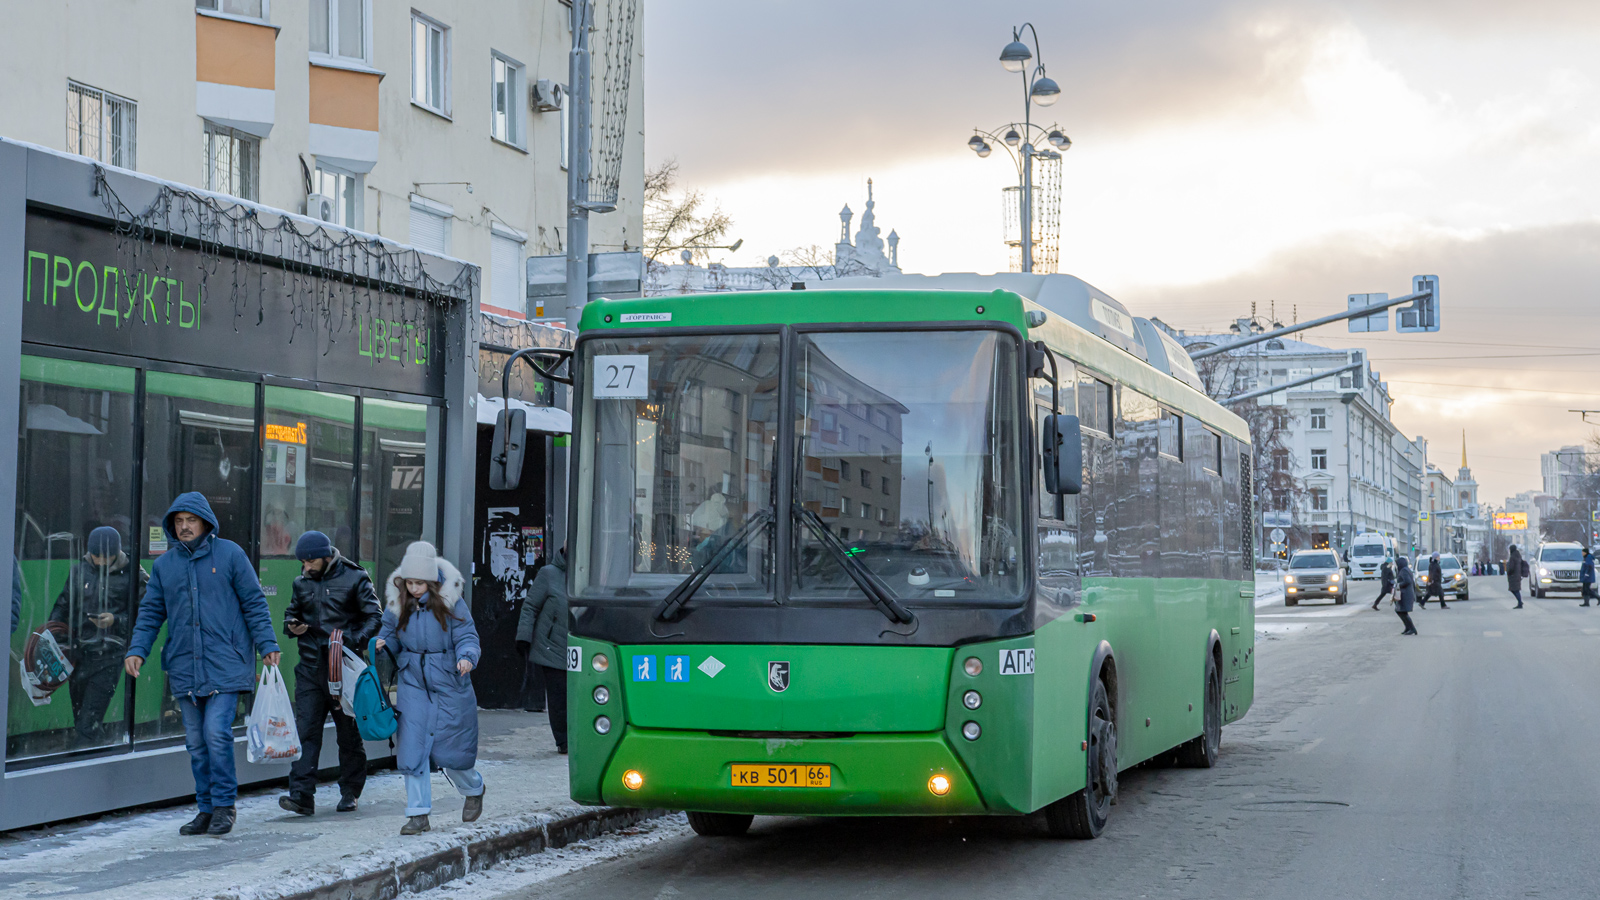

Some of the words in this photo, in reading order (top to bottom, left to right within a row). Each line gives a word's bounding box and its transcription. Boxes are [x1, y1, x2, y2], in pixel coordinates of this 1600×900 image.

[27, 250, 200, 330] ПРОДУКТЫ
[359, 314, 430, 367] ЦВЕТЫ
[605, 364, 636, 389] 27
[740, 771, 759, 784] КВ
[768, 767, 798, 784] 501
[808, 767, 824, 780] 66
